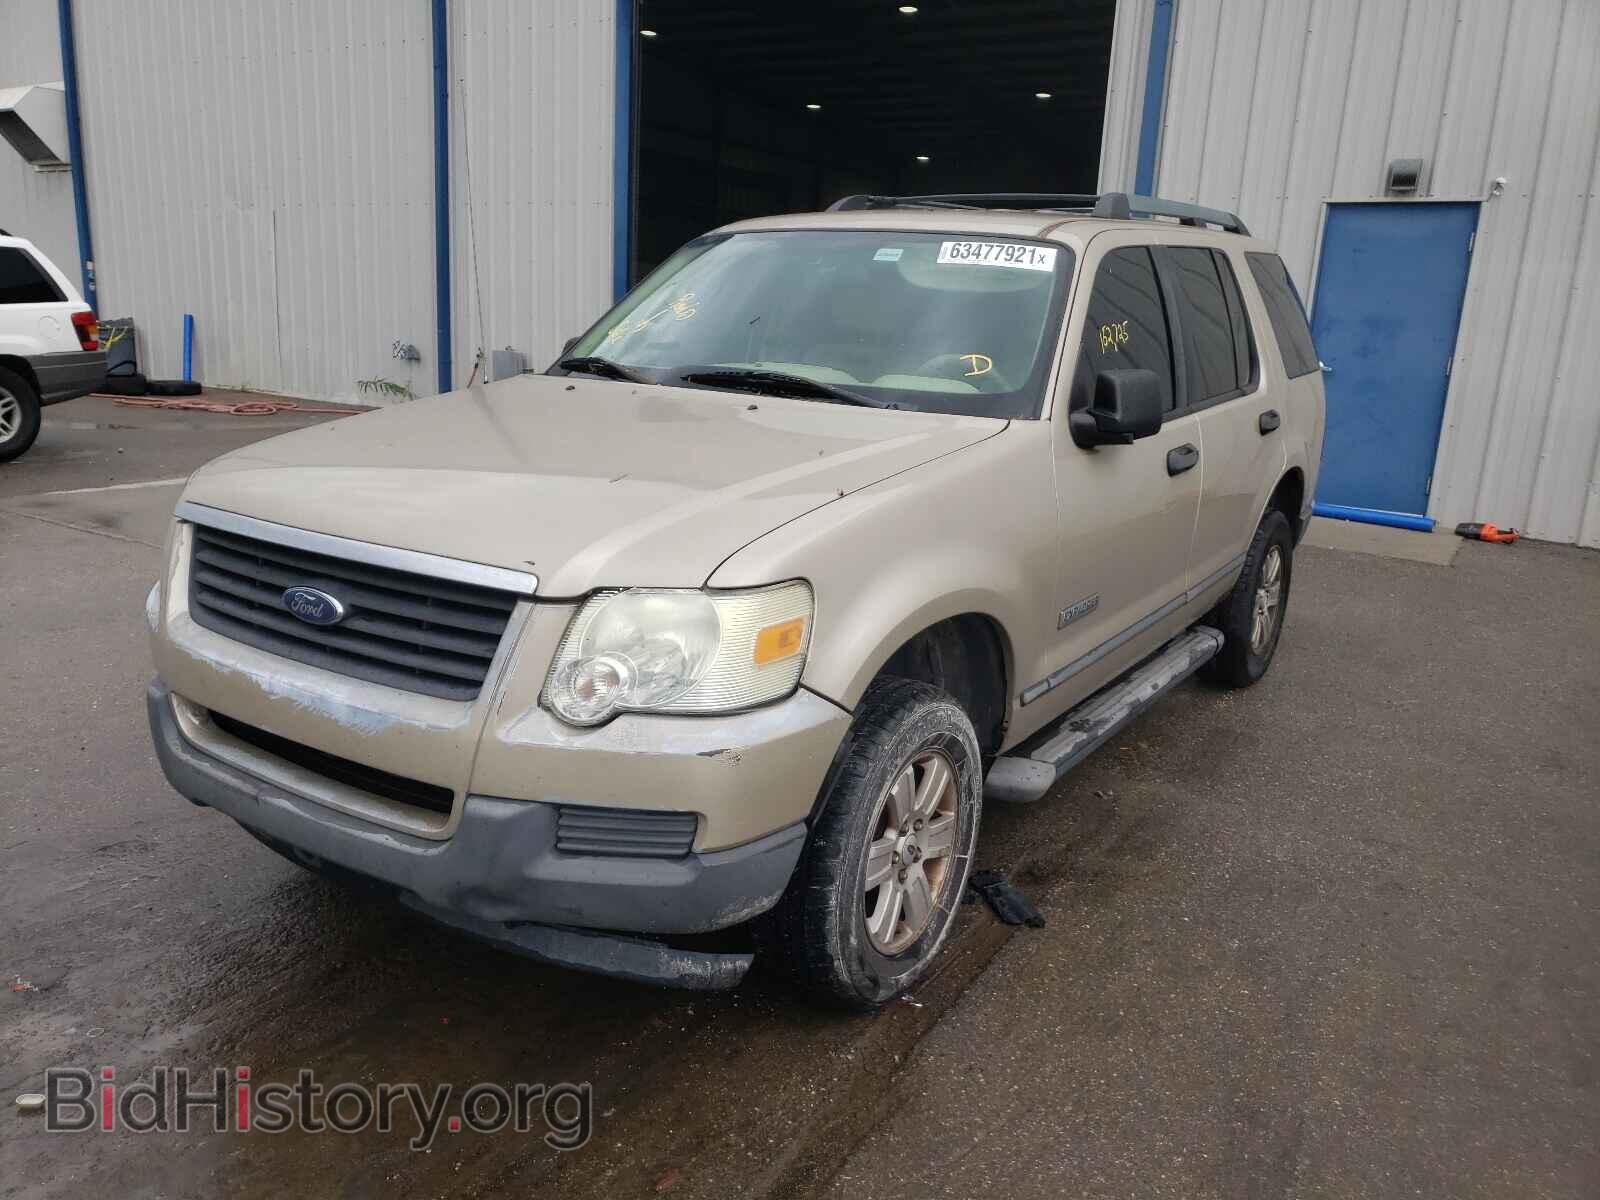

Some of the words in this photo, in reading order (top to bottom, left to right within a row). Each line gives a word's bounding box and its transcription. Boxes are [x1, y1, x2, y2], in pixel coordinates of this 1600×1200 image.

[949, 242, 1036, 265] 63477921
[959, 354, 993, 377] D
[290, 592, 325, 617] Ford
